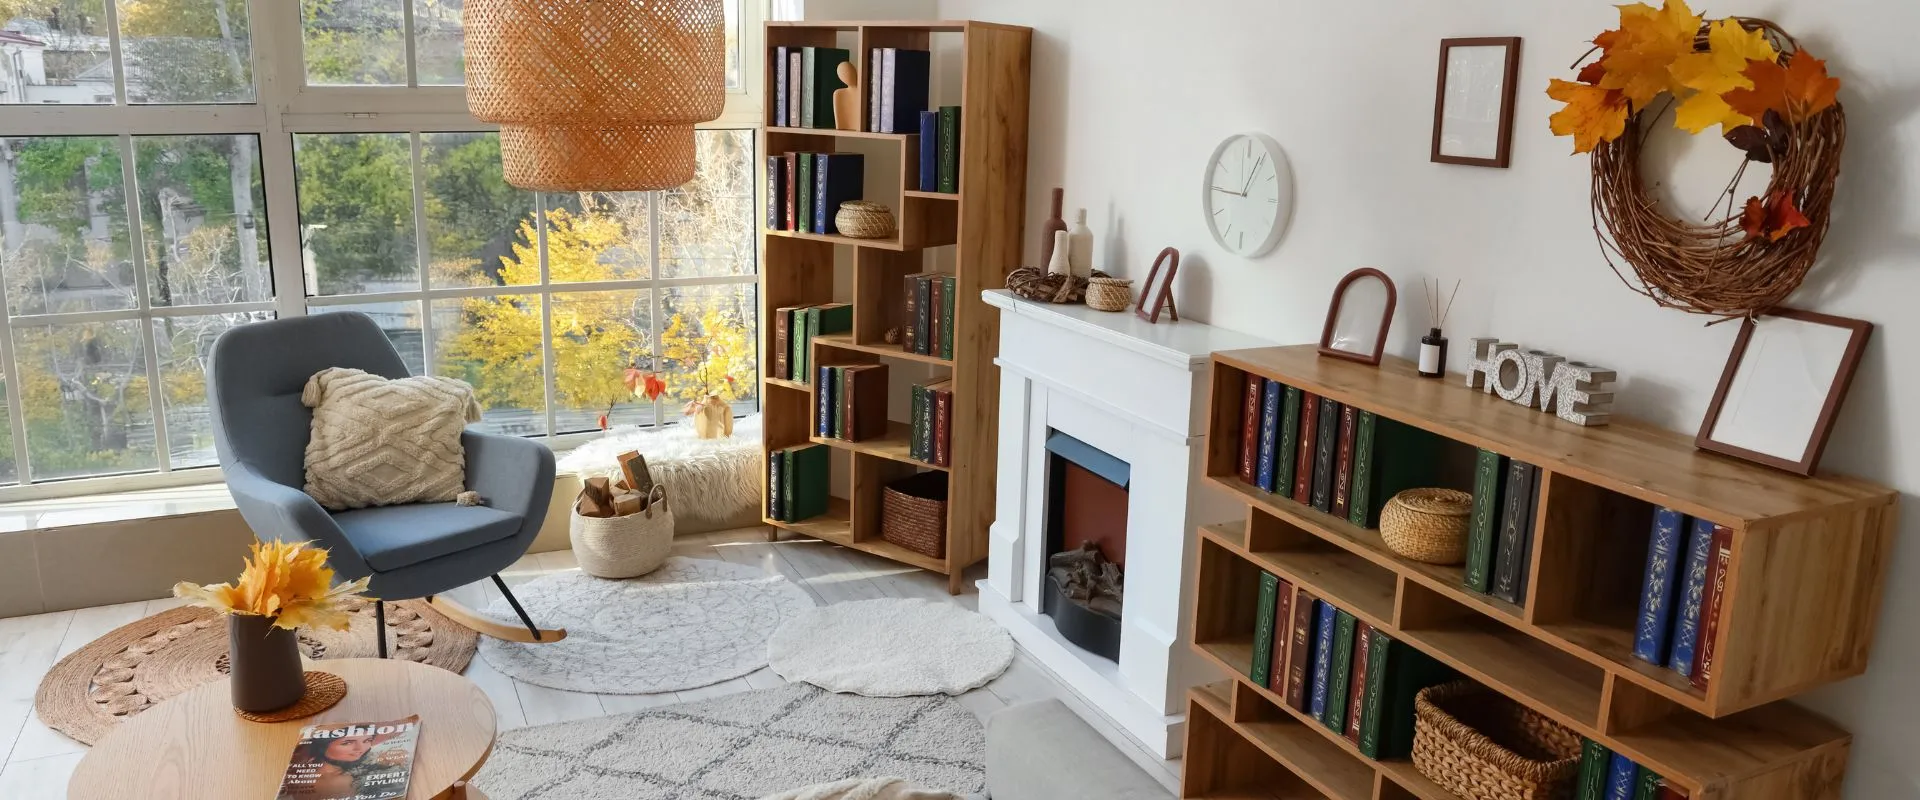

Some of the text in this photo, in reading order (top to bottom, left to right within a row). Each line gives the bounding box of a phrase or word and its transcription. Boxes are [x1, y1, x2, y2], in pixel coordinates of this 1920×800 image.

[1465, 337, 1592, 426] HOME
[300, 723, 414, 739] fashion
[364, 778, 406, 787] STYLING
[366, 771, 407, 782] EXPERT
